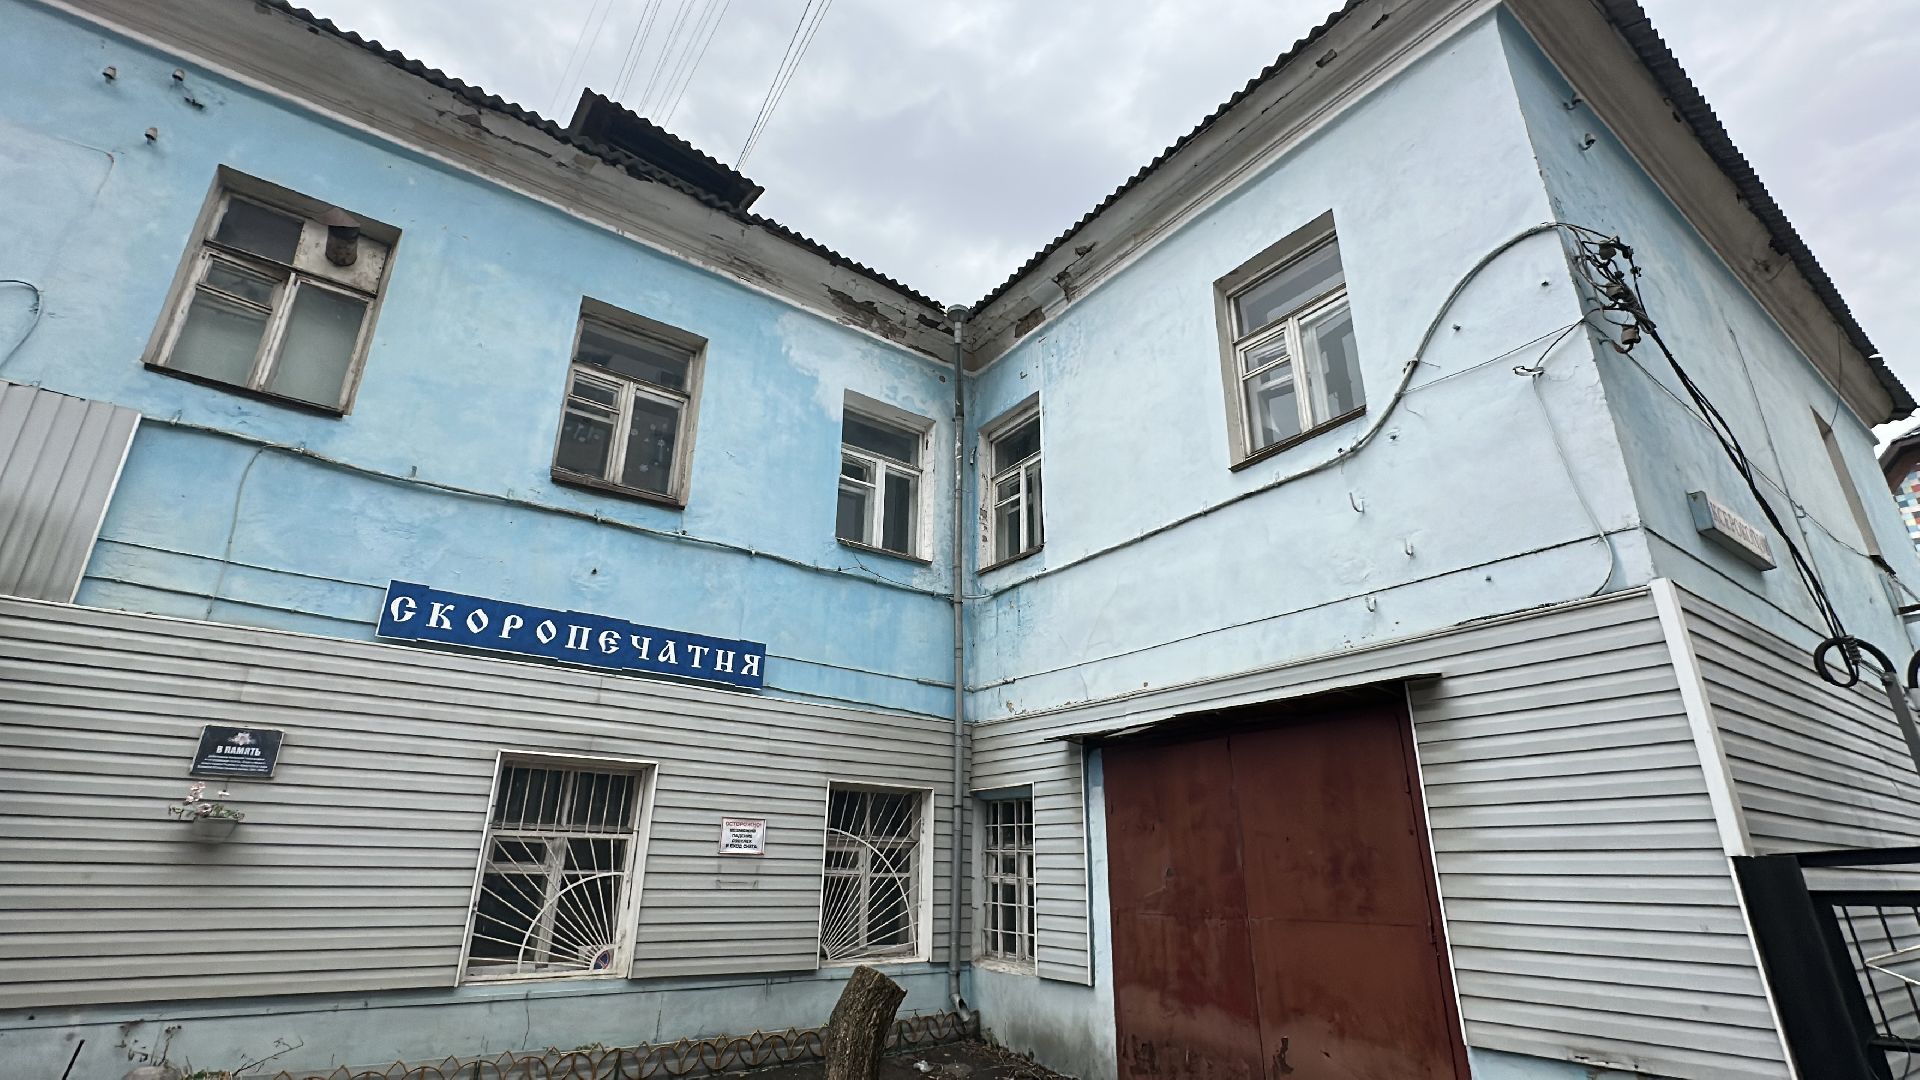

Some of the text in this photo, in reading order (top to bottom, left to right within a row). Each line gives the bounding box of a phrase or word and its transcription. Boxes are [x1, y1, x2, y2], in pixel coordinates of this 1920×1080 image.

[390, 596, 762, 678] СКОРОПЕЧАТНЯ
[216, 745, 261, 757] В ПАМЯТЬ
